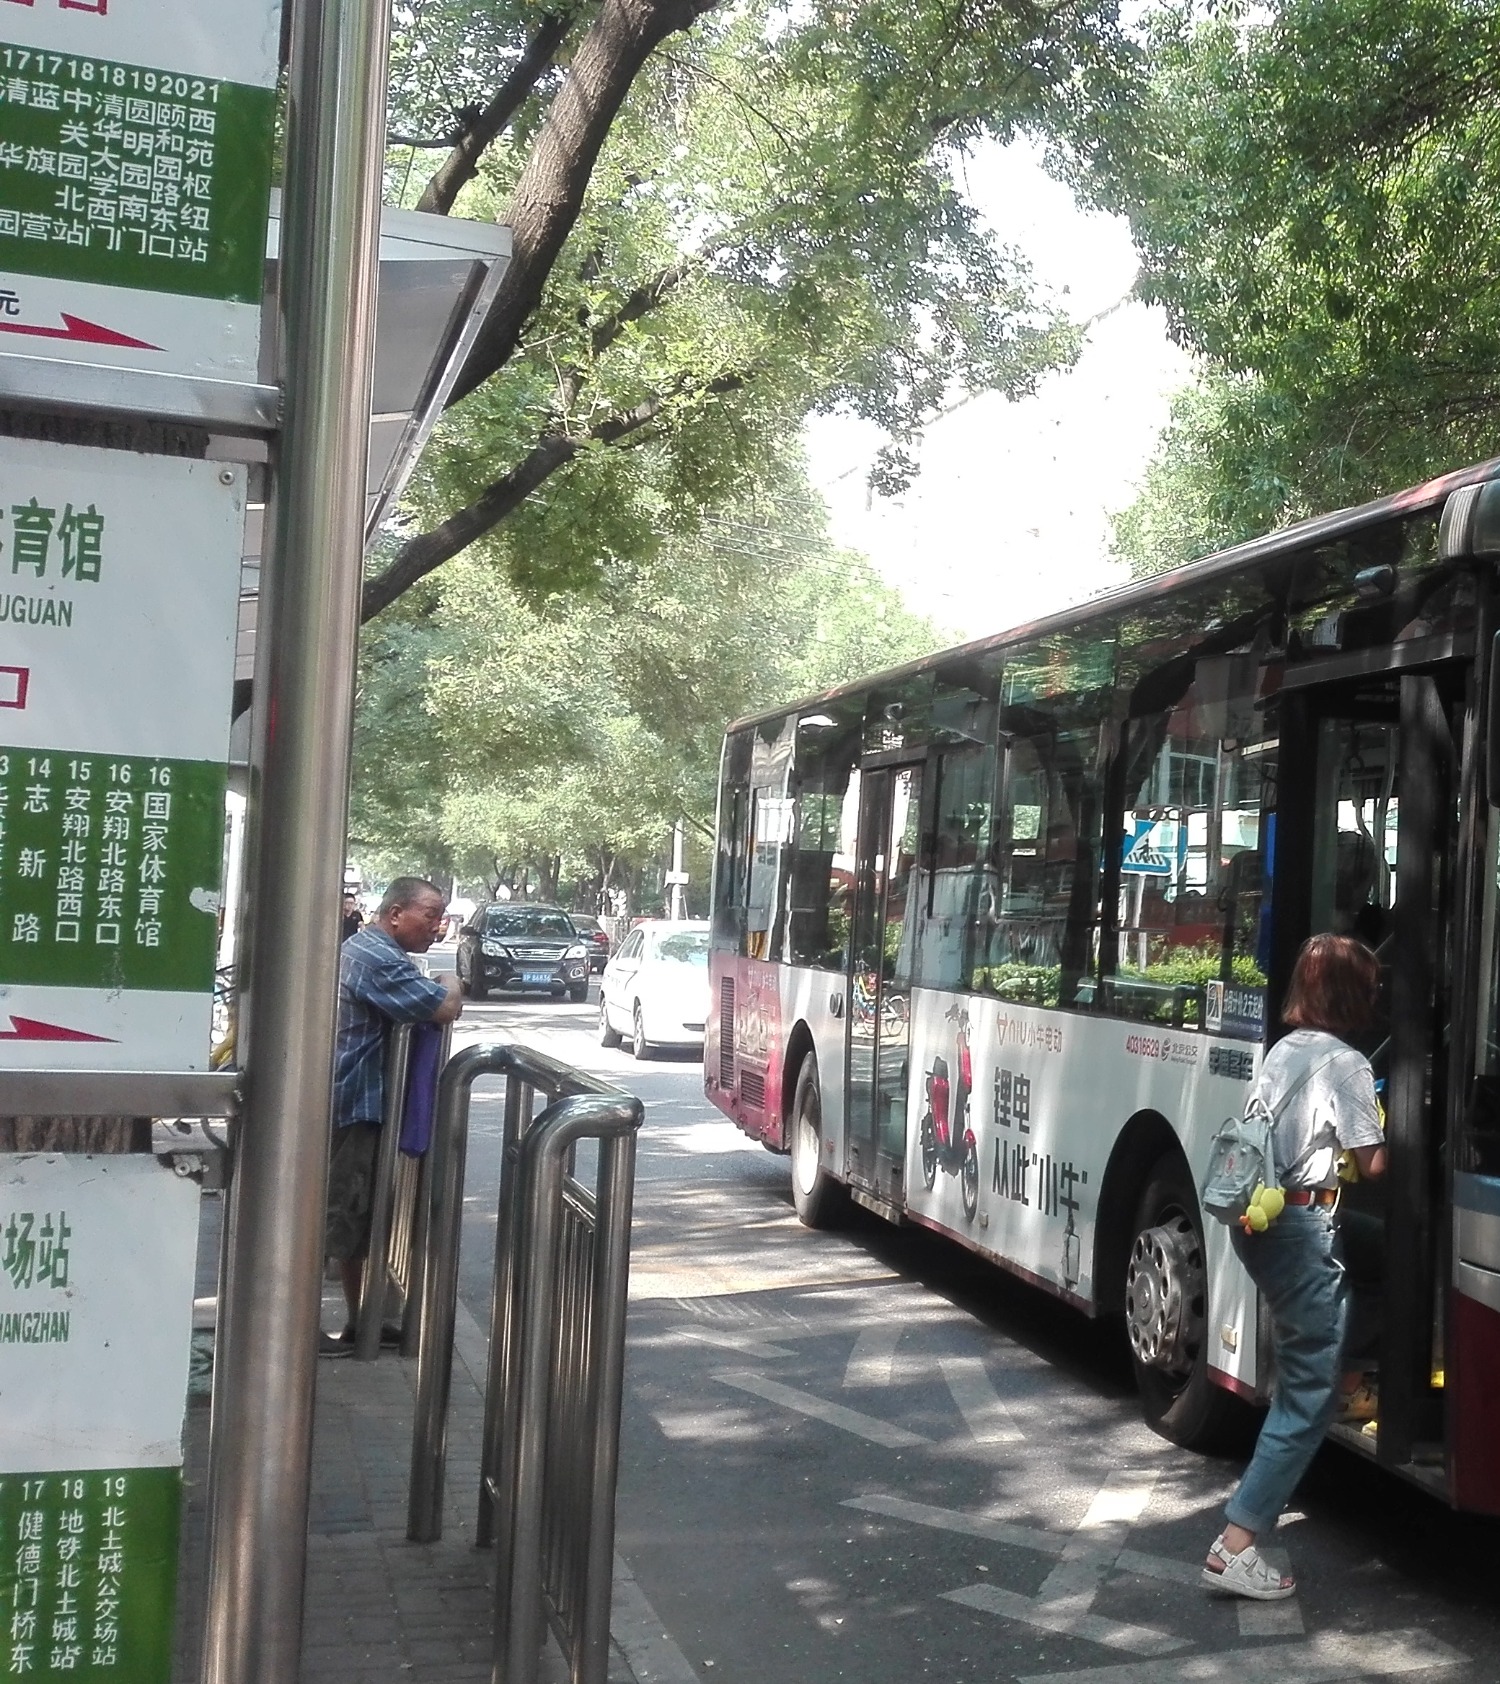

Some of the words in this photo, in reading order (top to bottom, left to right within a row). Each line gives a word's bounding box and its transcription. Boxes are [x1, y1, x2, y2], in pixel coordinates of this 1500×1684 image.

[0, 496, 104, 583] 育馆
[28, 757, 51, 779] 14
[69, 760, 92, 781] 15
[109, 764, 131, 784] 16
[149, 766, 171, 786] 16
[12, 784, 51, 943] 志新路
[56, 787, 91, 943] 安翔北路西口
[95, 790, 132, 945] 安翔北路东口
[135, 792, 171, 947] 国家体育馆
[994, 1066, 1031, 1134] 锂电
[2, 1211, 71, 1289] 场站
[22, 1480, 46, 1501] 17
[62, 1478, 84, 1499] 18
[103, 1477, 126, 1498] 19
[9, 1511, 44, 1674] 健德门桥东
[50, 1508, 84, 1670] 地铁北土城站
[92, 1506, 125, 1666] 北土城公交场站
